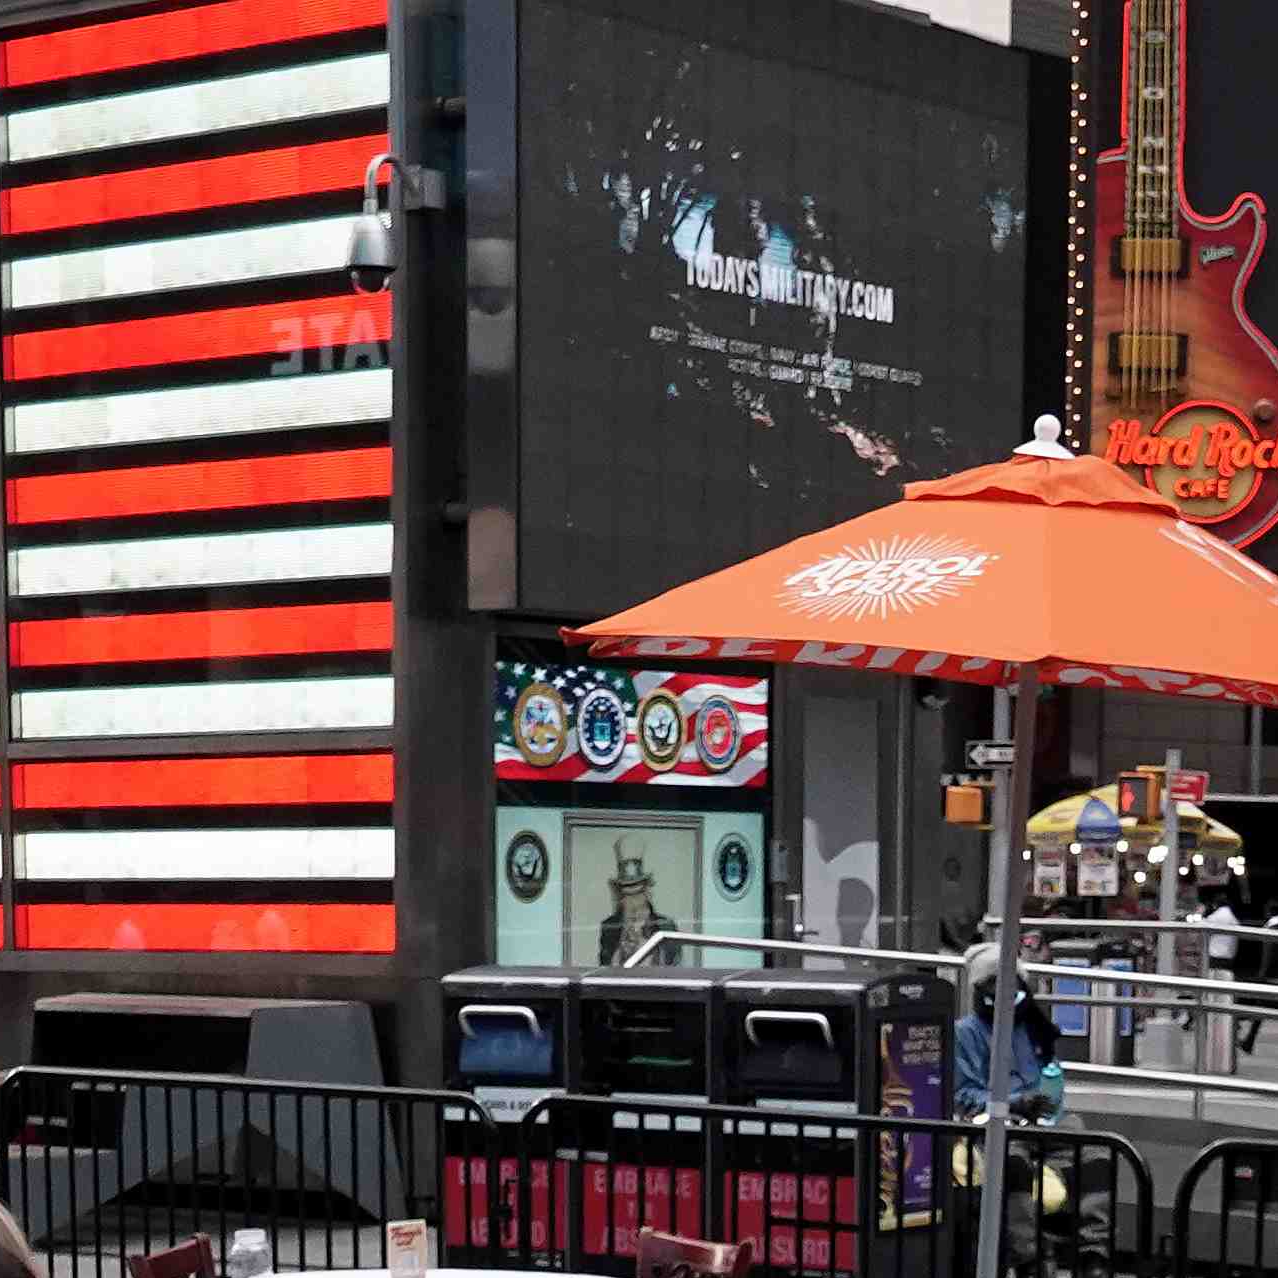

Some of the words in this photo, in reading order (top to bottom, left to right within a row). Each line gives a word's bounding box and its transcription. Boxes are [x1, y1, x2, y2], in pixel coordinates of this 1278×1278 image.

[1106, 418, 1203, 468] Hard
[1174, 476, 1230, 499] CAFE
[783, 554, 989, 586] APEROL
